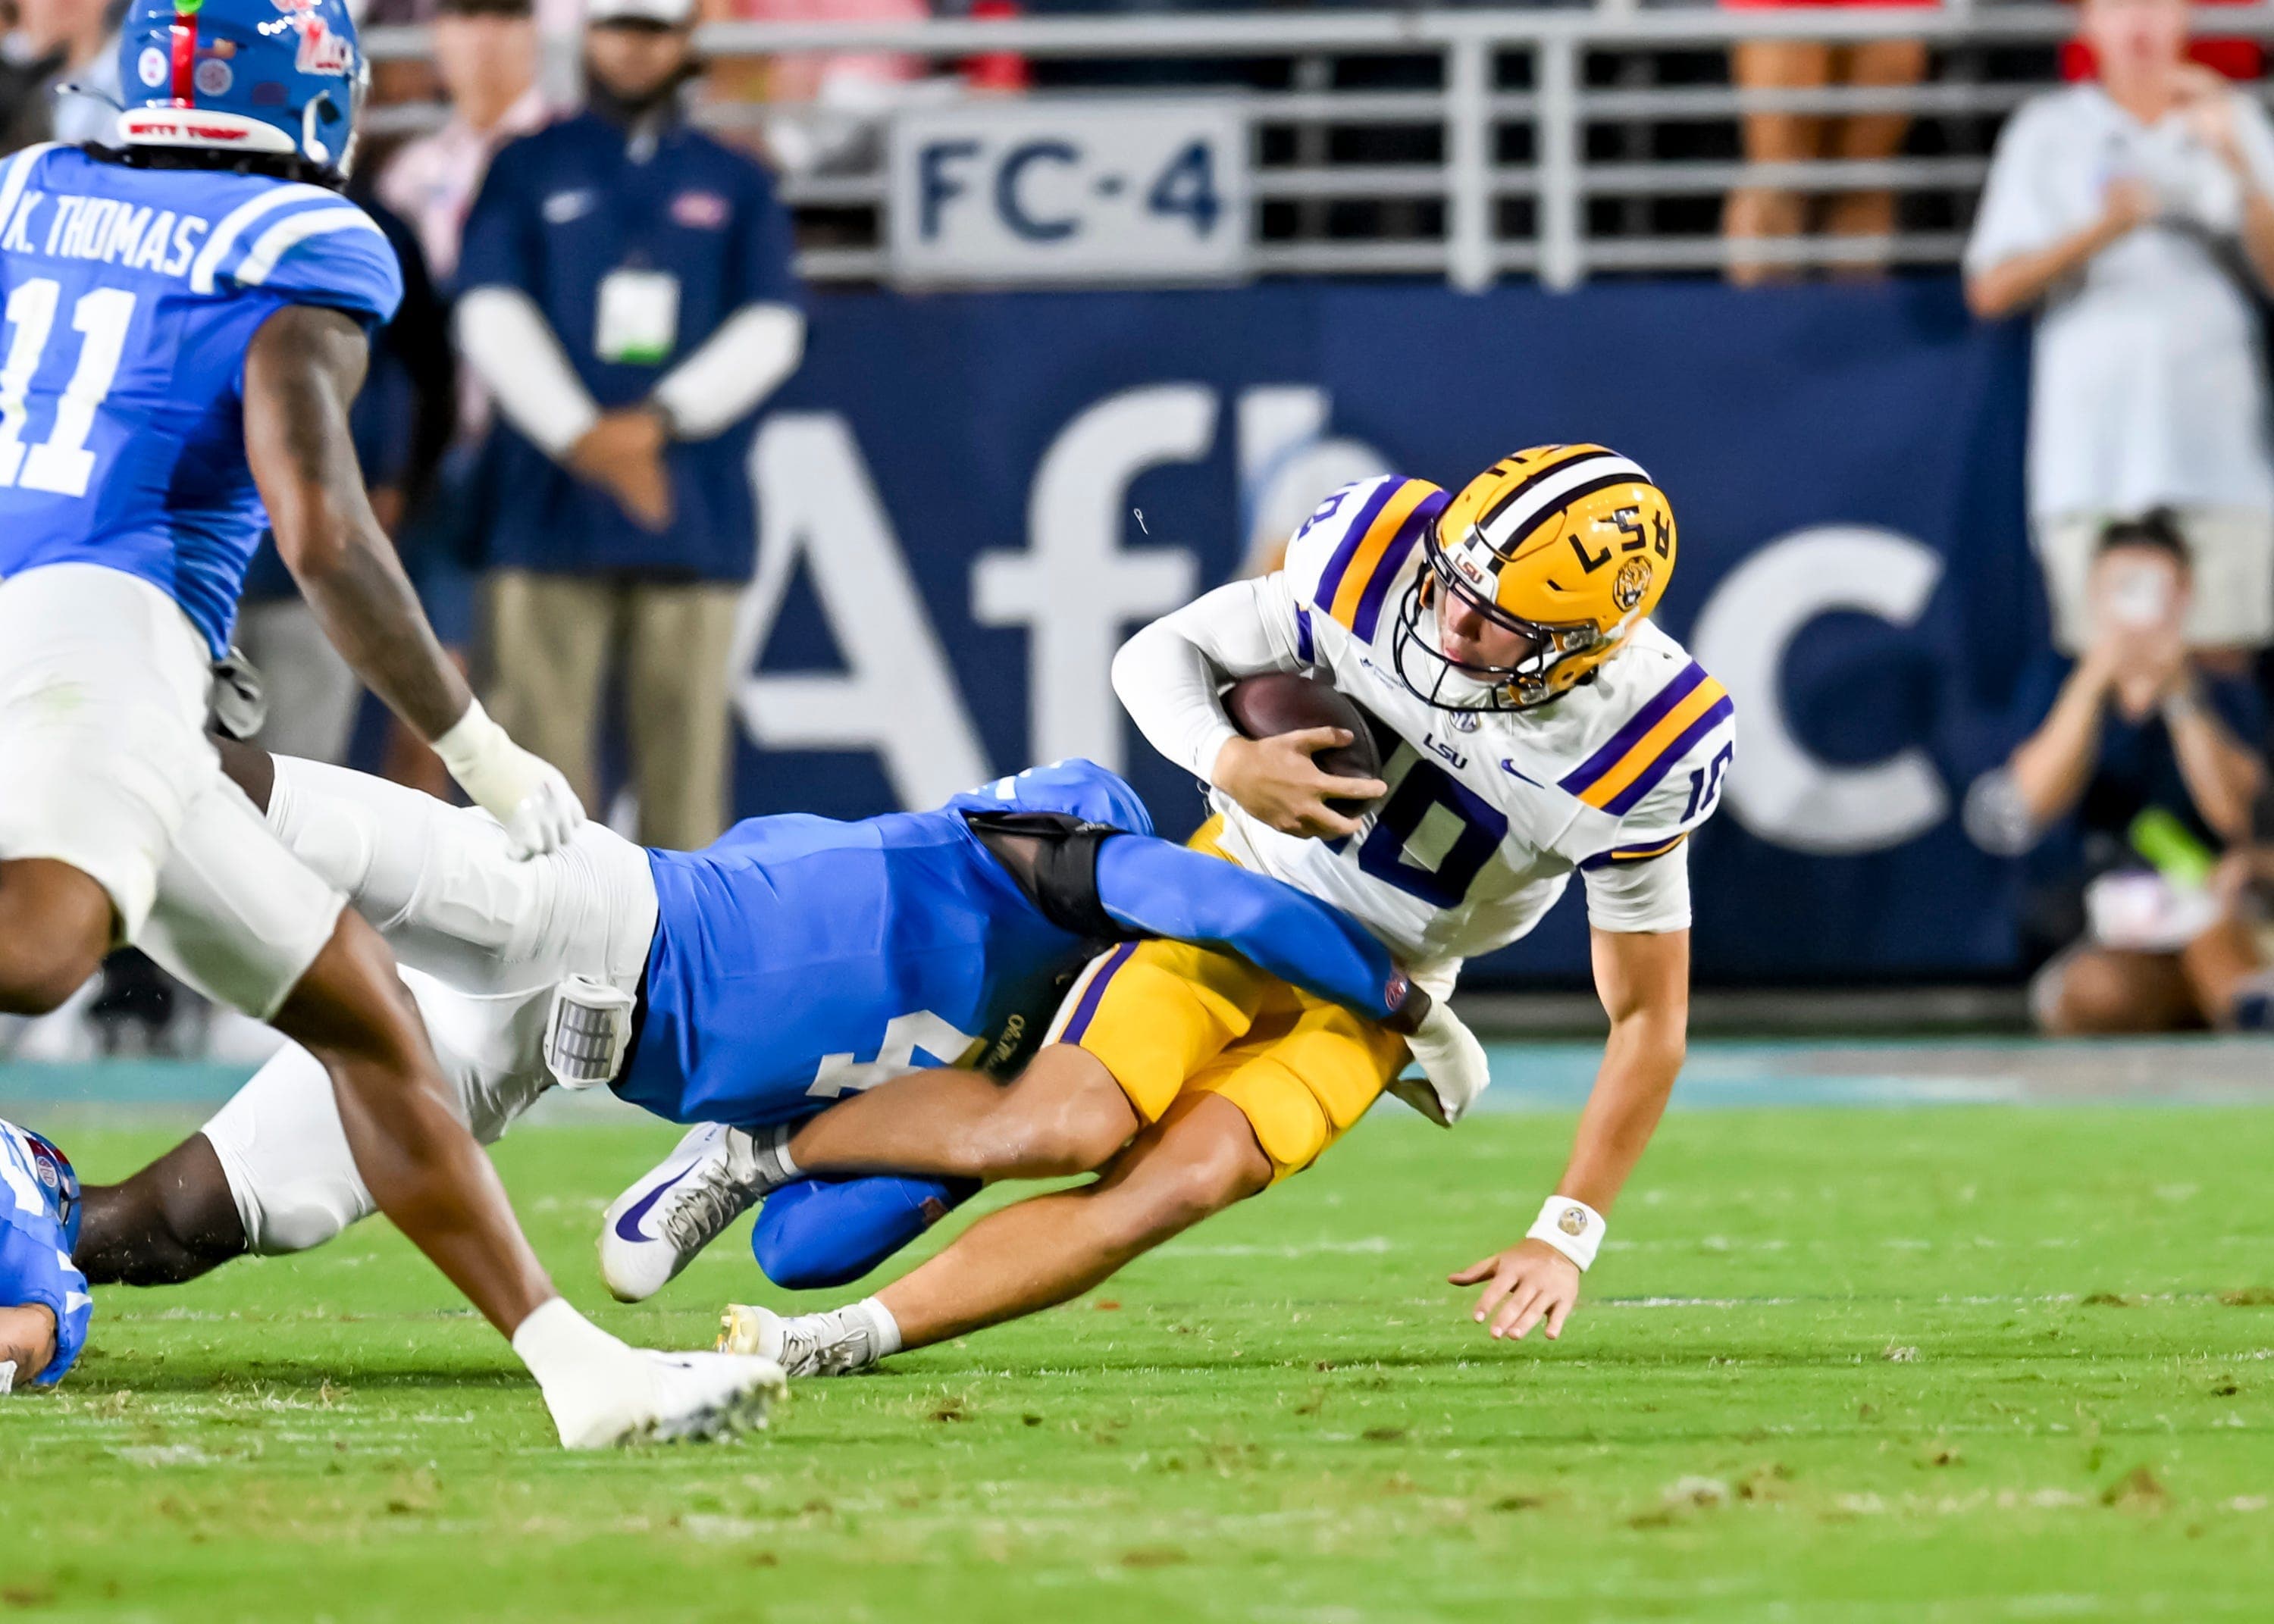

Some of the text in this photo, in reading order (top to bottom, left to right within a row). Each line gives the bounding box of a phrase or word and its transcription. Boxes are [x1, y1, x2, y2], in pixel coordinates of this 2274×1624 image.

[2, 189, 208, 277] K. THOMAS
[919, 138, 1222, 243] FC-4
[0, 277, 136, 498] 11
[1454, 552, 1484, 585] LSU
[732, 382, 1950, 856] Afc
[1424, 732, 1467, 769] LSU
